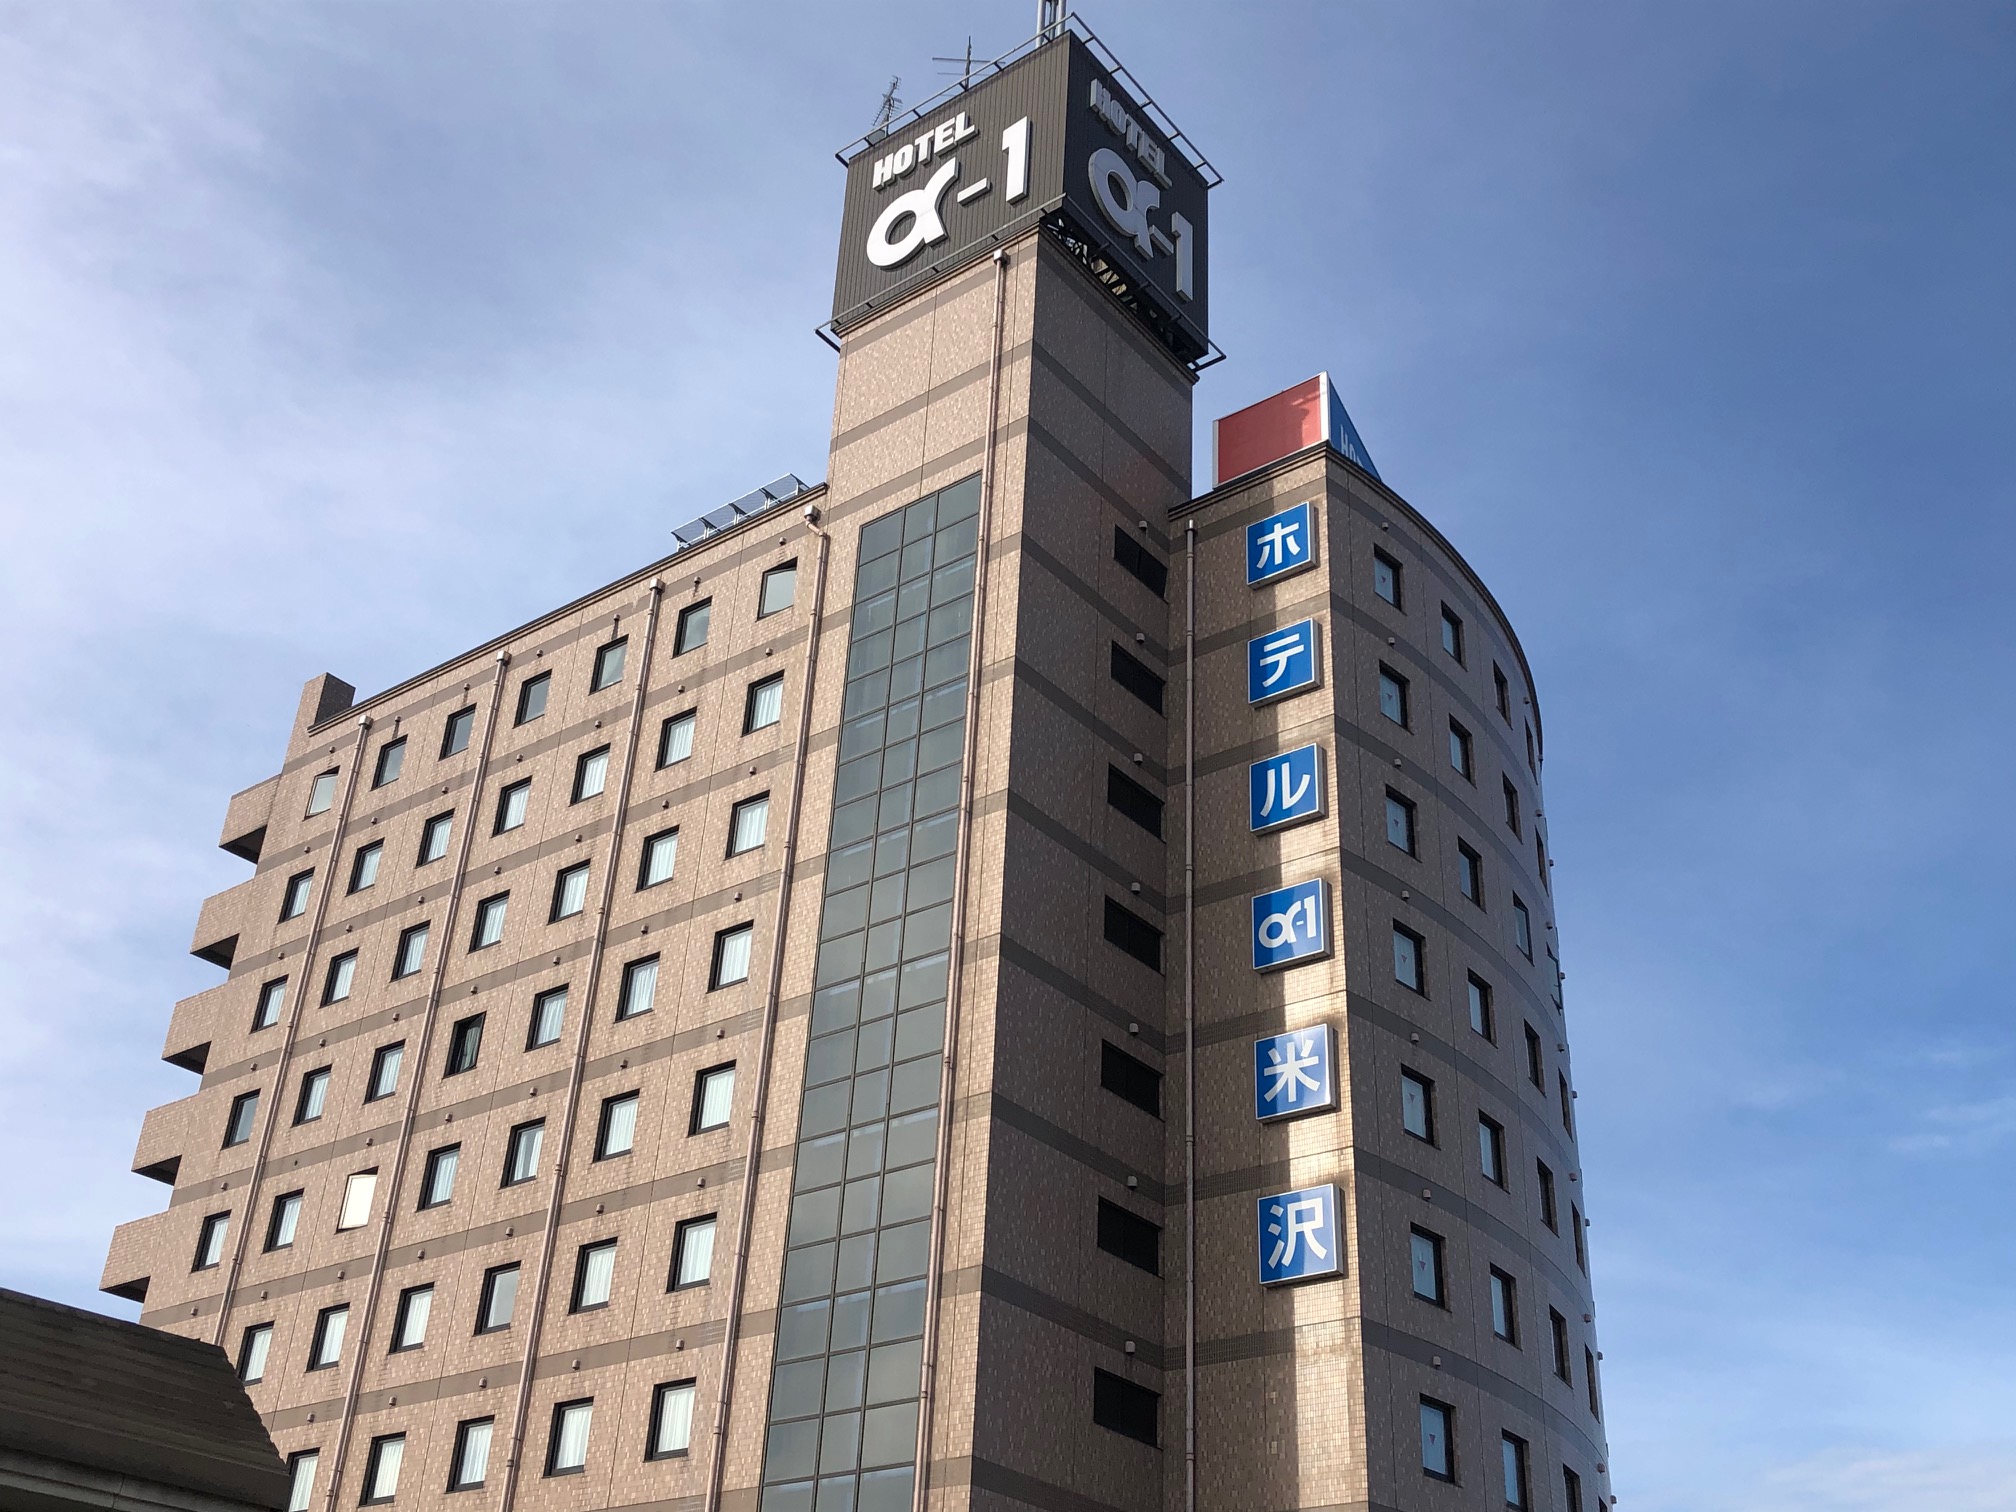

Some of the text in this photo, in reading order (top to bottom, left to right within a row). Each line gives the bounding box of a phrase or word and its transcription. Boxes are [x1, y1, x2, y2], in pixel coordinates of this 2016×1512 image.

[872, 111, 975, 188] HOTEL
[1090, 78, 1172, 188] HOTEL
[1257, 522, 1311, 817] ホテル
[1264, 1038, 1328, 1269] 米沢
